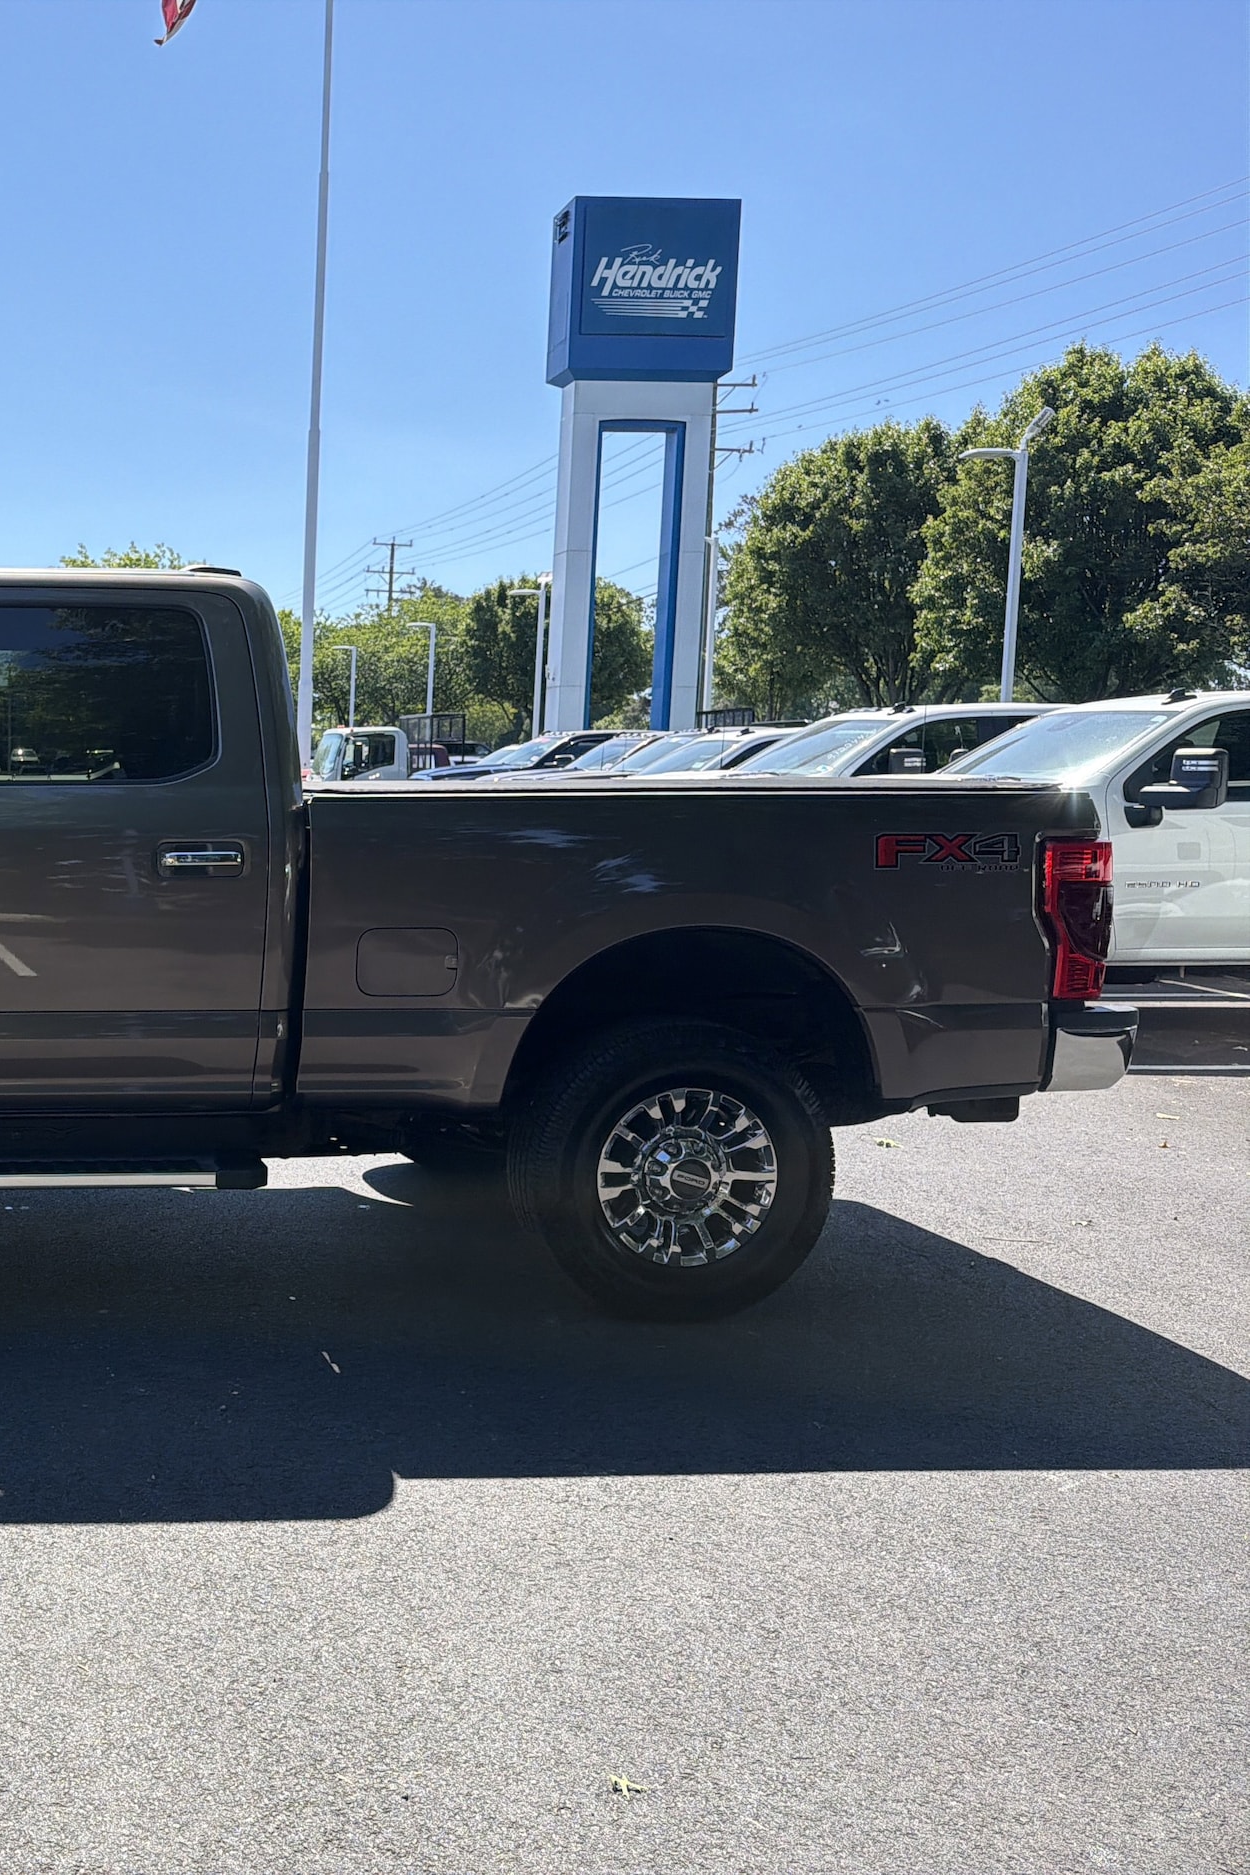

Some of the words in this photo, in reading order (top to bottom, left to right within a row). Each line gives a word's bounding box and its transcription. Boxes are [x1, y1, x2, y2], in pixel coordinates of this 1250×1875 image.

[620, 243, 663, 265] Rick
[591, 257, 723, 297] Hendrick
[612, 288, 662, 298] CHEVROLET
[663, 289, 689, 299] BUICK
[691, 290, 713, 299] GMC
[874, 832, 1022, 870] FX4
